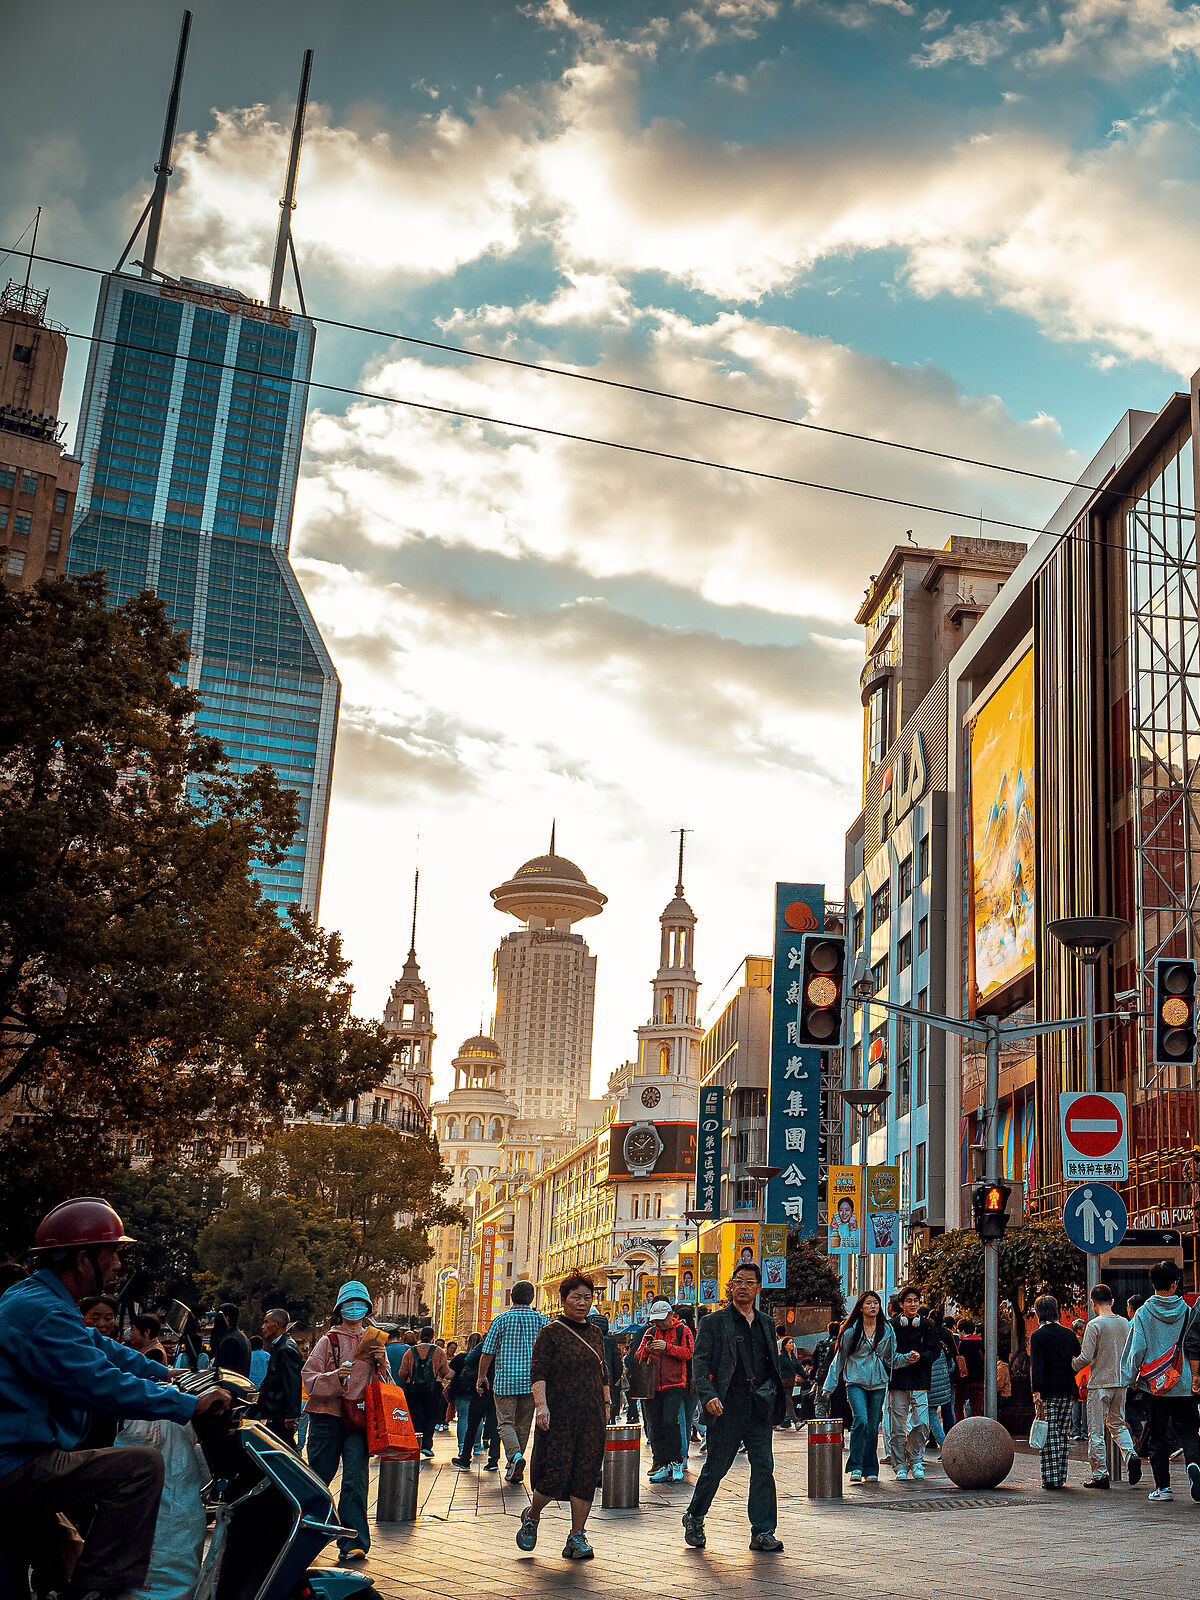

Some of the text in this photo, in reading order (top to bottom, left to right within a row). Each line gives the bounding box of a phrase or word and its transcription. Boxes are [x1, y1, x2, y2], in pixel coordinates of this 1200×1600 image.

[1068, 1162, 1122, 1176] 除特种车辆外
